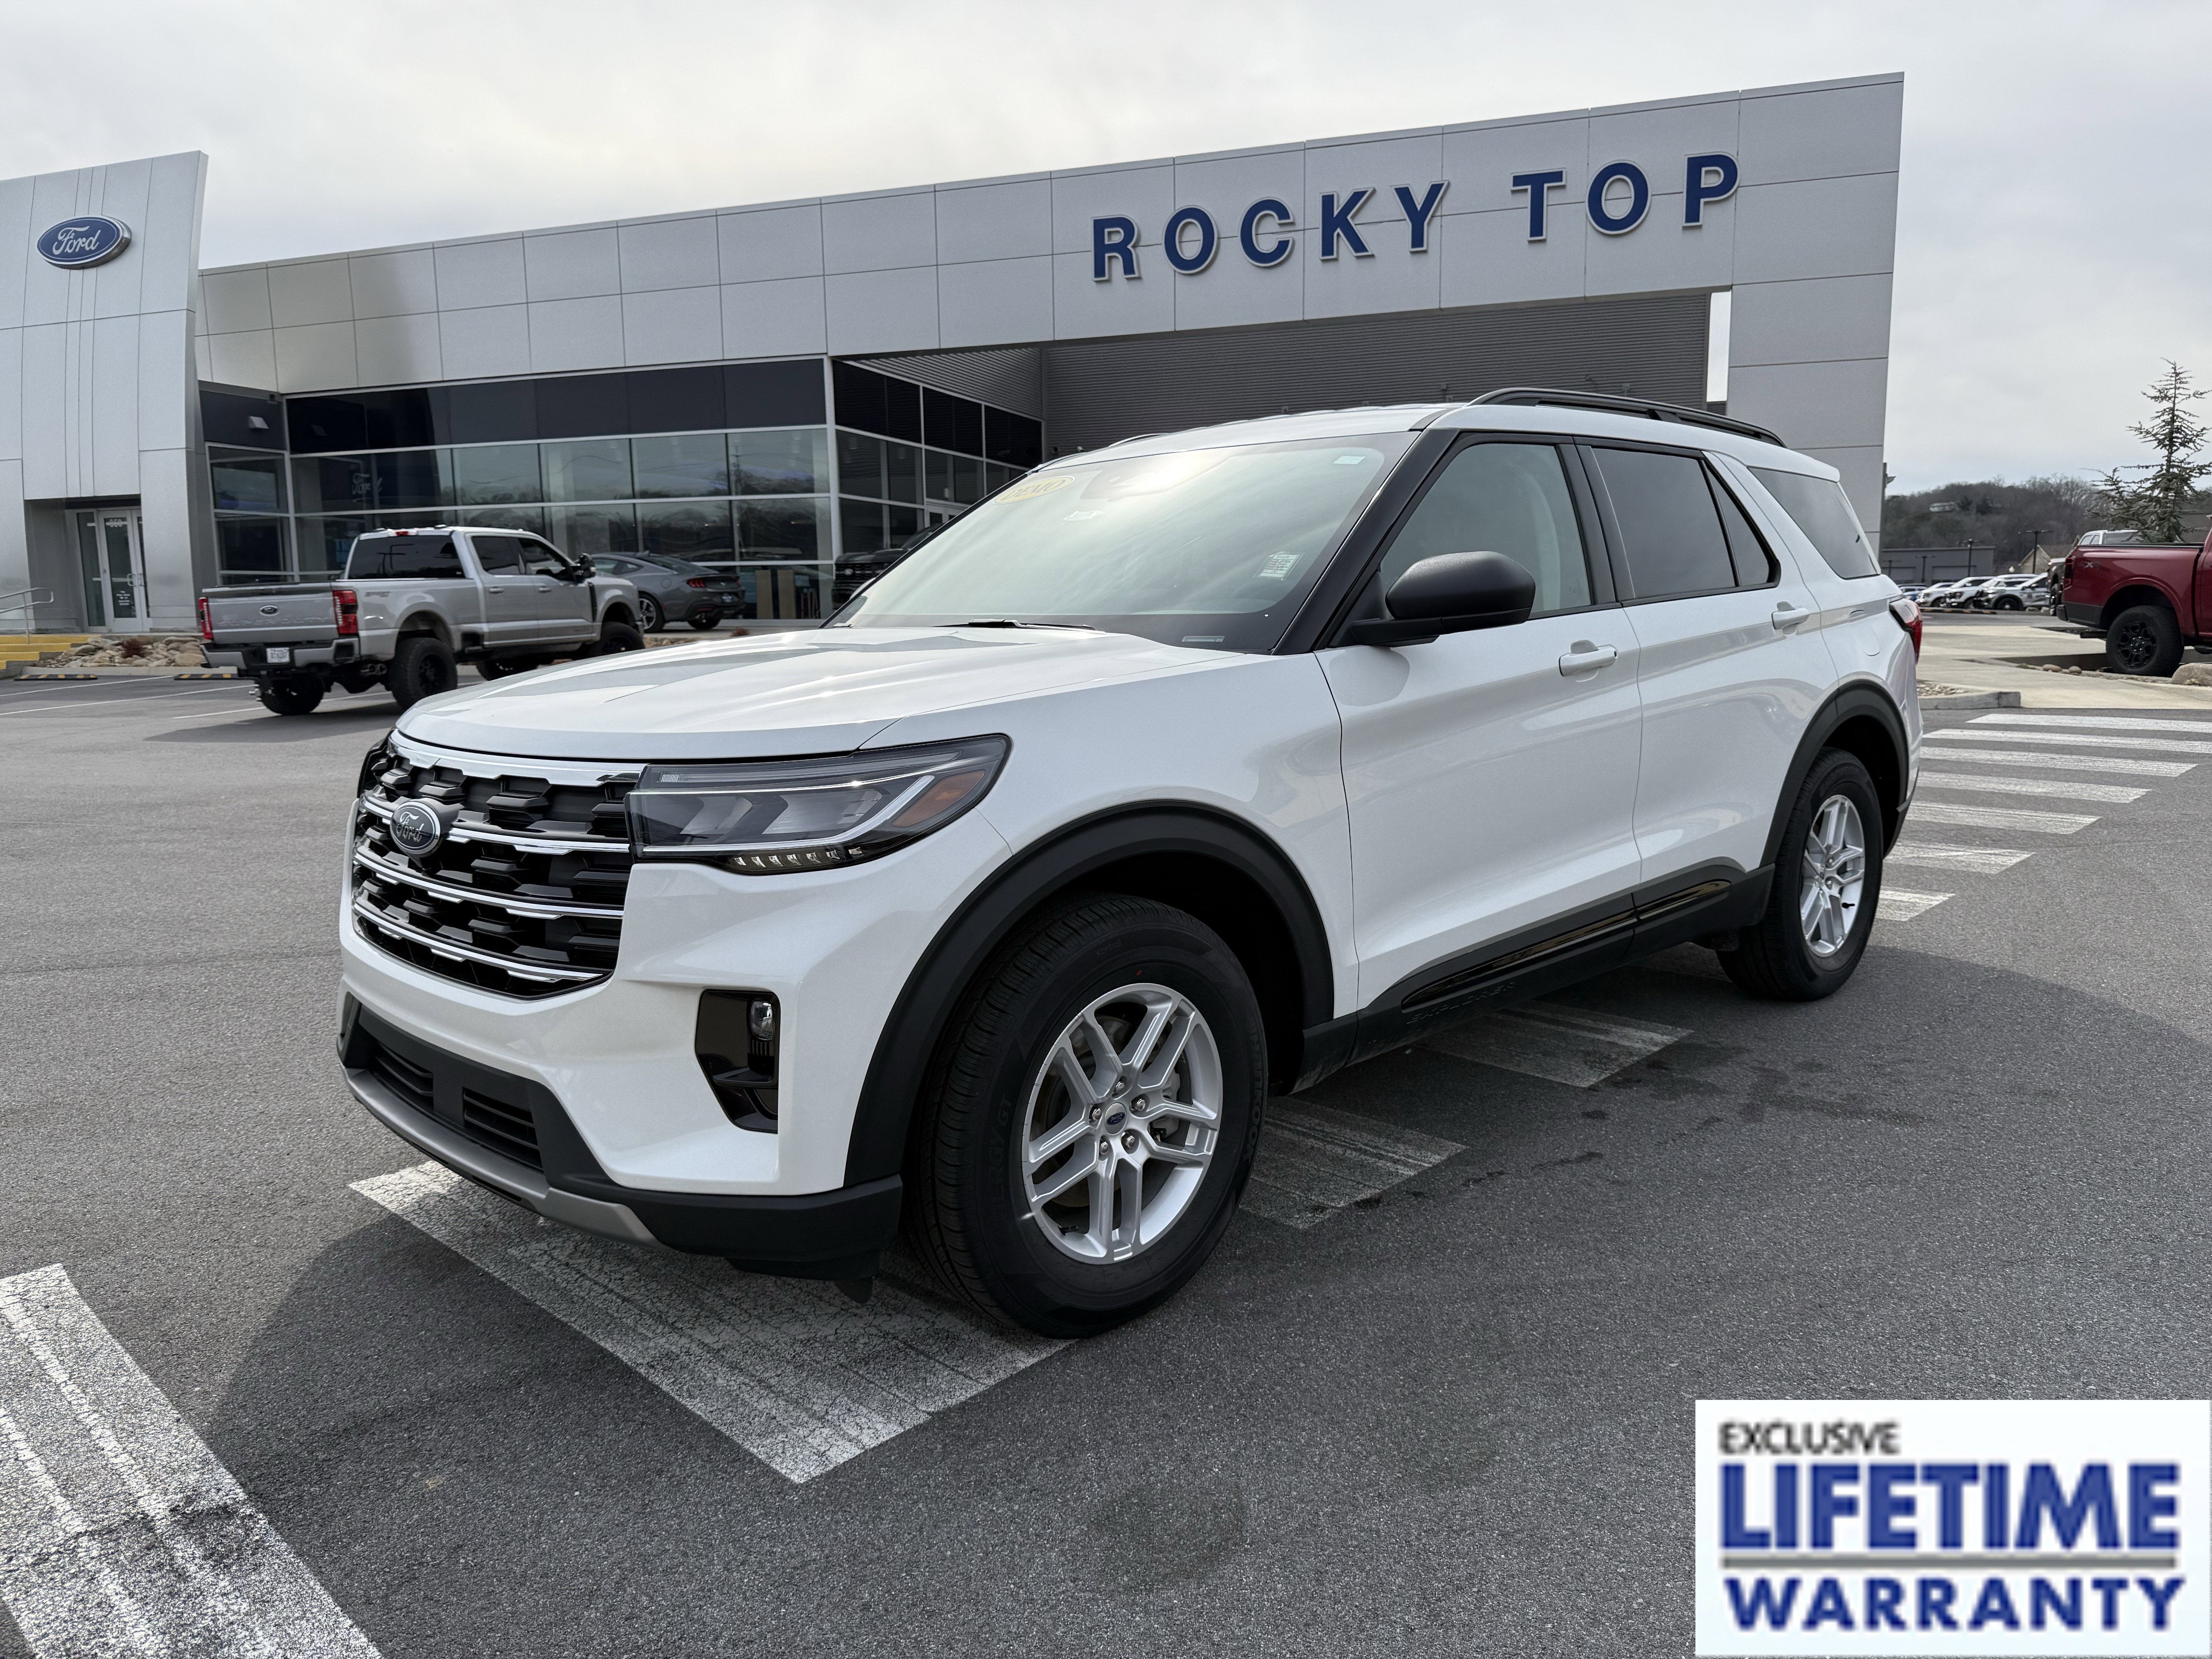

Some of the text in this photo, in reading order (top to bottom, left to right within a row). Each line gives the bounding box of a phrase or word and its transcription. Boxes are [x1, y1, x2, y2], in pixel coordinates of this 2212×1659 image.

[1092, 153, 1740, 282] ROCKY TOP
[52, 225, 101, 255] Ford
[396, 812, 424, 843] Ford
[1095, 939, 1122, 958] Kontrol
[1406, 981, 1517, 1025] EXPLORER
